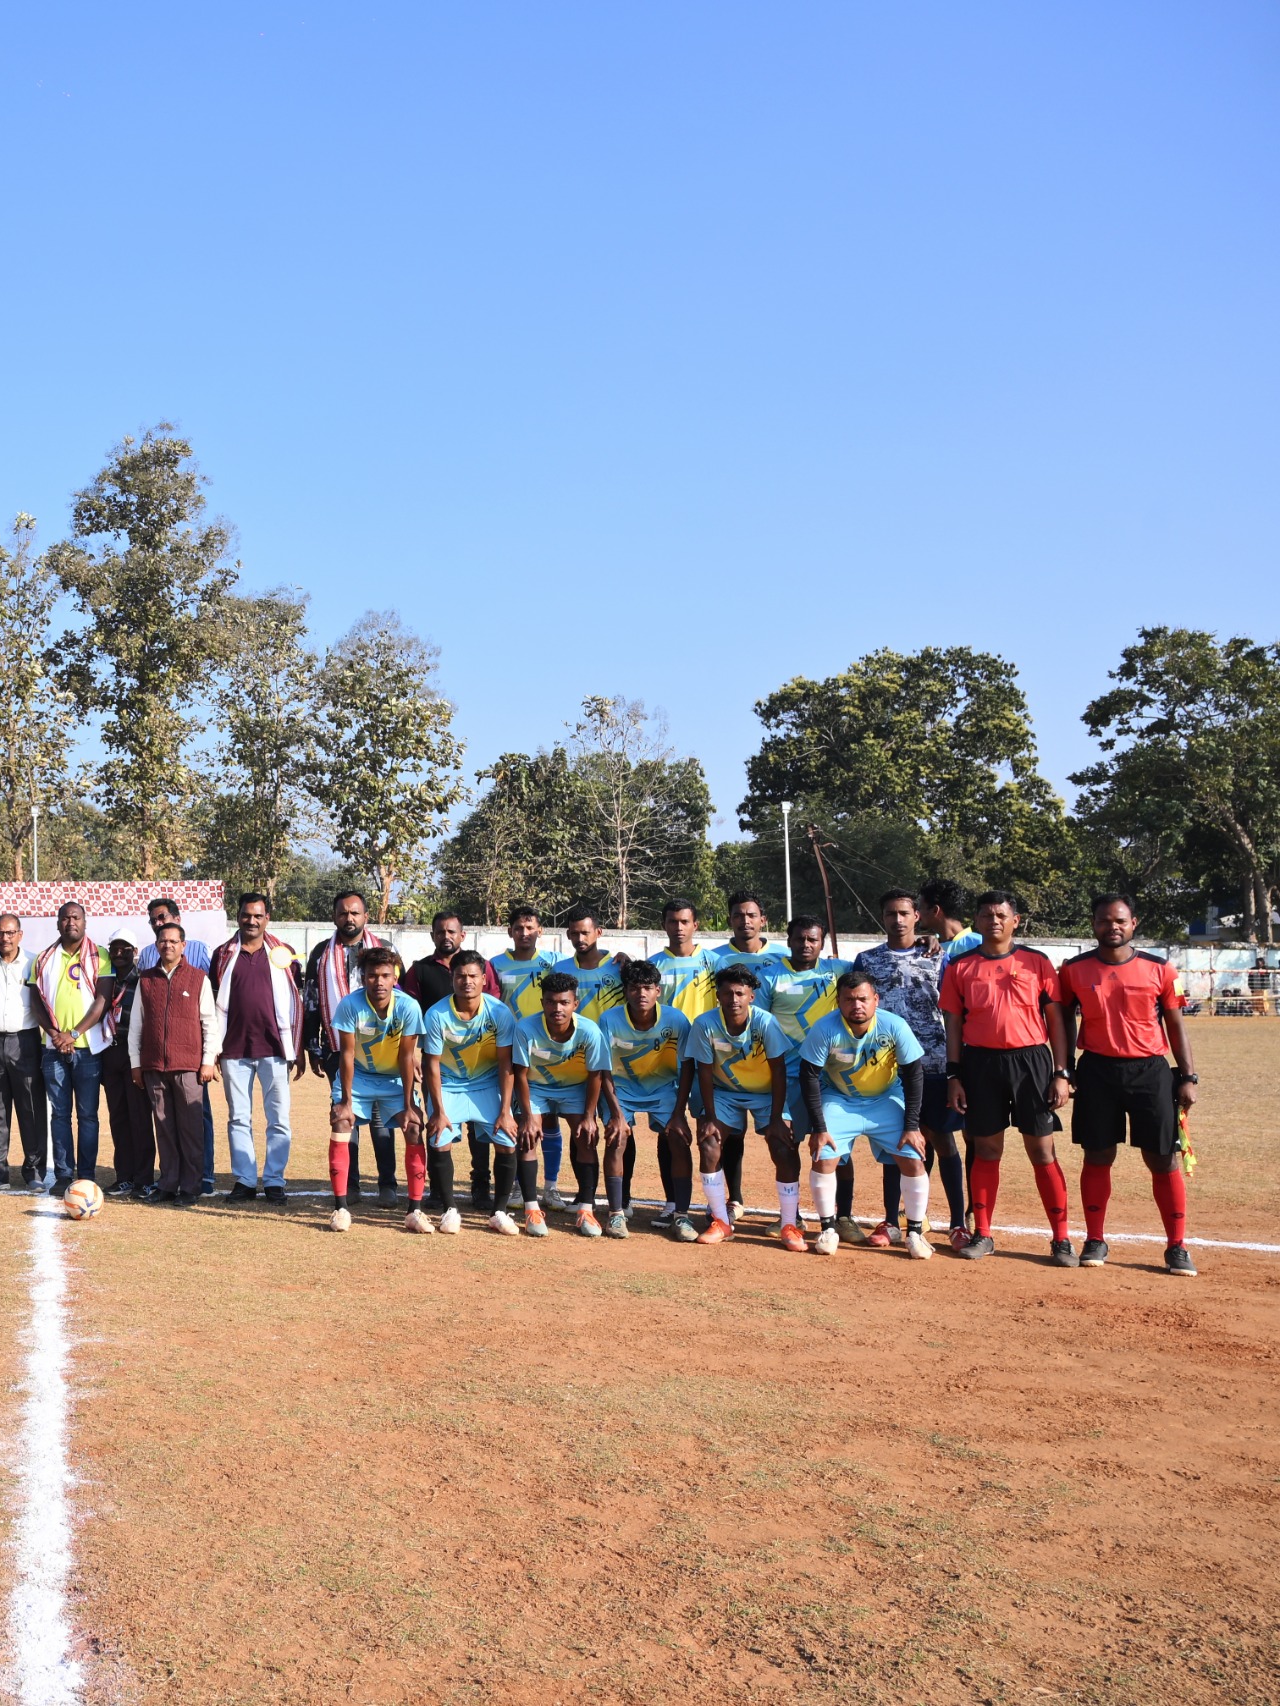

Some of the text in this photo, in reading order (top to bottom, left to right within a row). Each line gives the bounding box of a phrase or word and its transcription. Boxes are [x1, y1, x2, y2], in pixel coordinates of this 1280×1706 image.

[594, 983, 601, 1001] 7
[812, 980, 828, 998] 11
[653, 1038, 661, 1052] 8
[861, 1048, 878, 1067] 13
